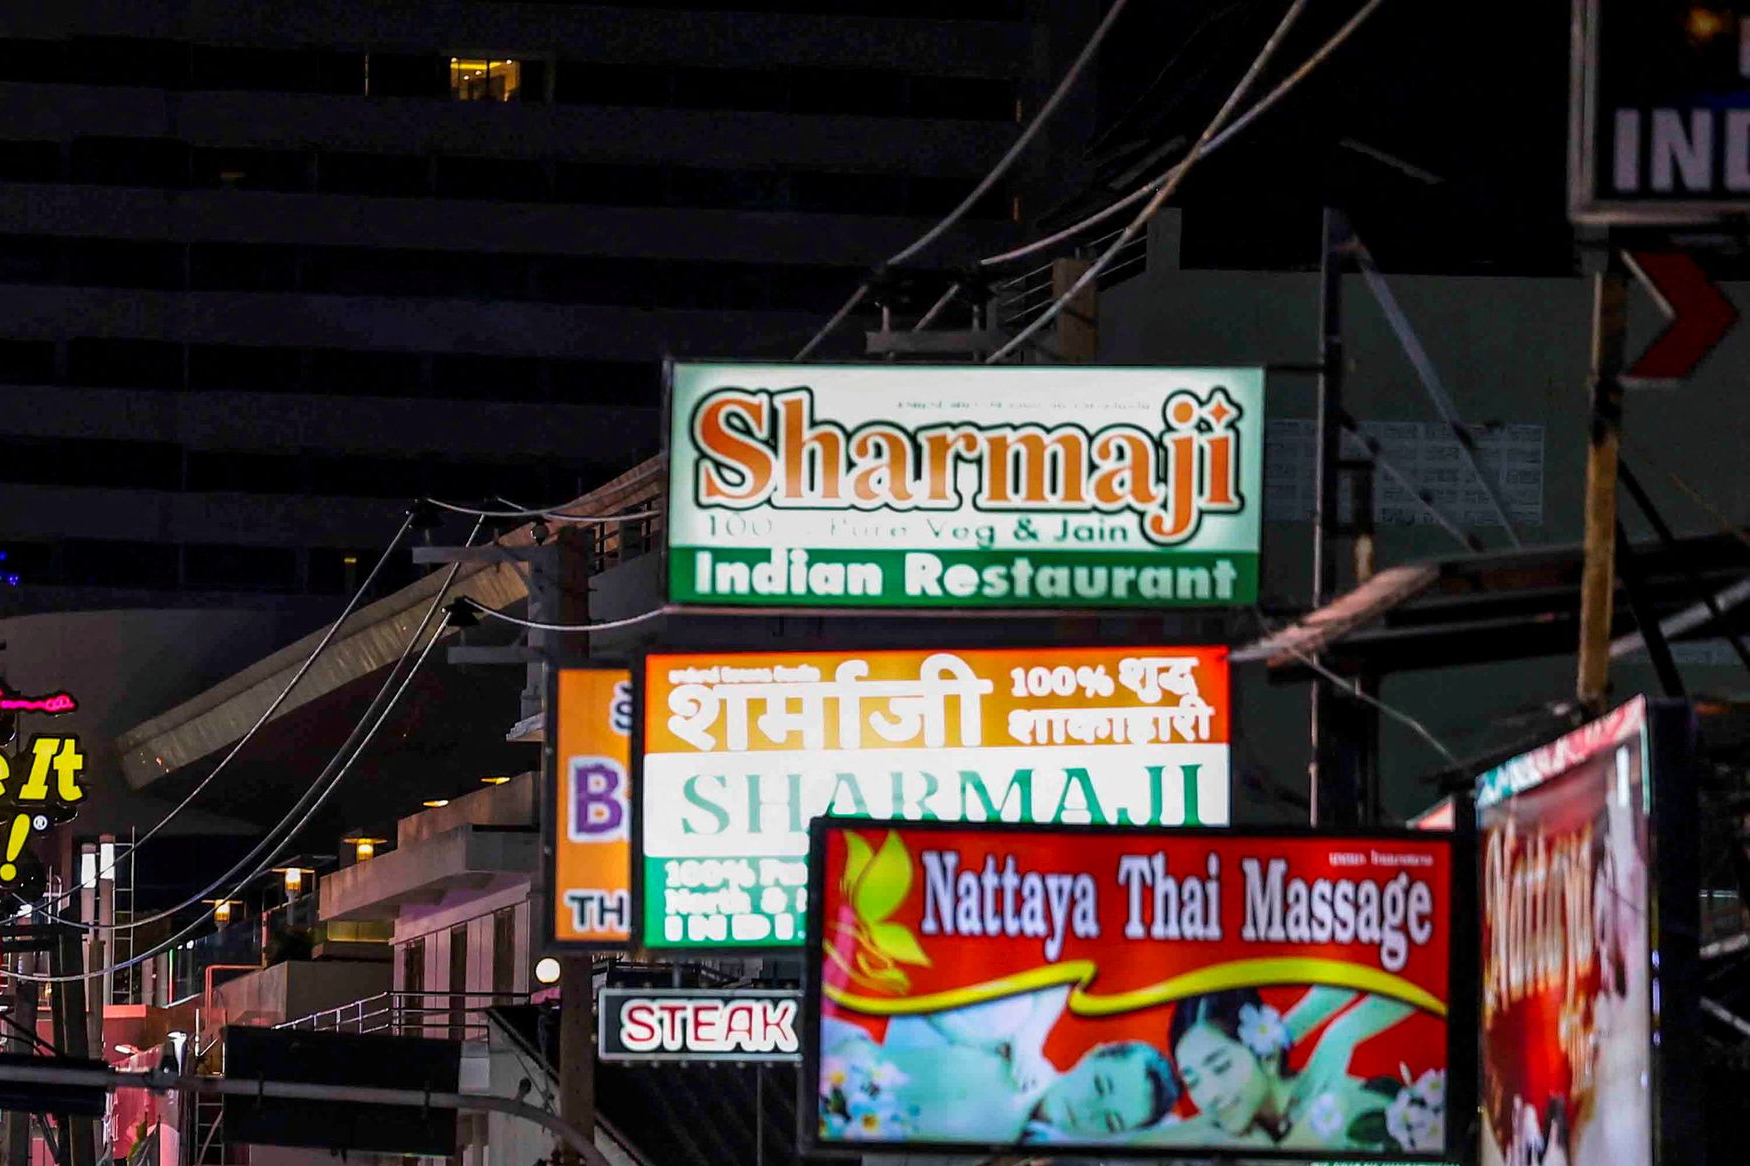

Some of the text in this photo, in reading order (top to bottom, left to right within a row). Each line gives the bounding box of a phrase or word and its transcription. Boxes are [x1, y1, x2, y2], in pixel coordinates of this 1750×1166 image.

[693, 394, 1243, 538] Sharmaji
[926, 517, 996, 548] Veg
[1013, 516, 1041, 542] &
[1054, 517, 1129, 543] Jain
[695, 550, 1238, 599] Indian Restaurant
[1010, 664, 1115, 698] 100%
[21, 737, 84, 801] It
[681, 763, 1205, 836] SHARMAJI
[665, 913, 806, 941] INDI
[920, 851, 1101, 962] Nattaya
[1117, 853, 1223, 942] Thai
[1242, 857, 1433, 972] Massage
[625, 1002, 797, 1046] STEAK
